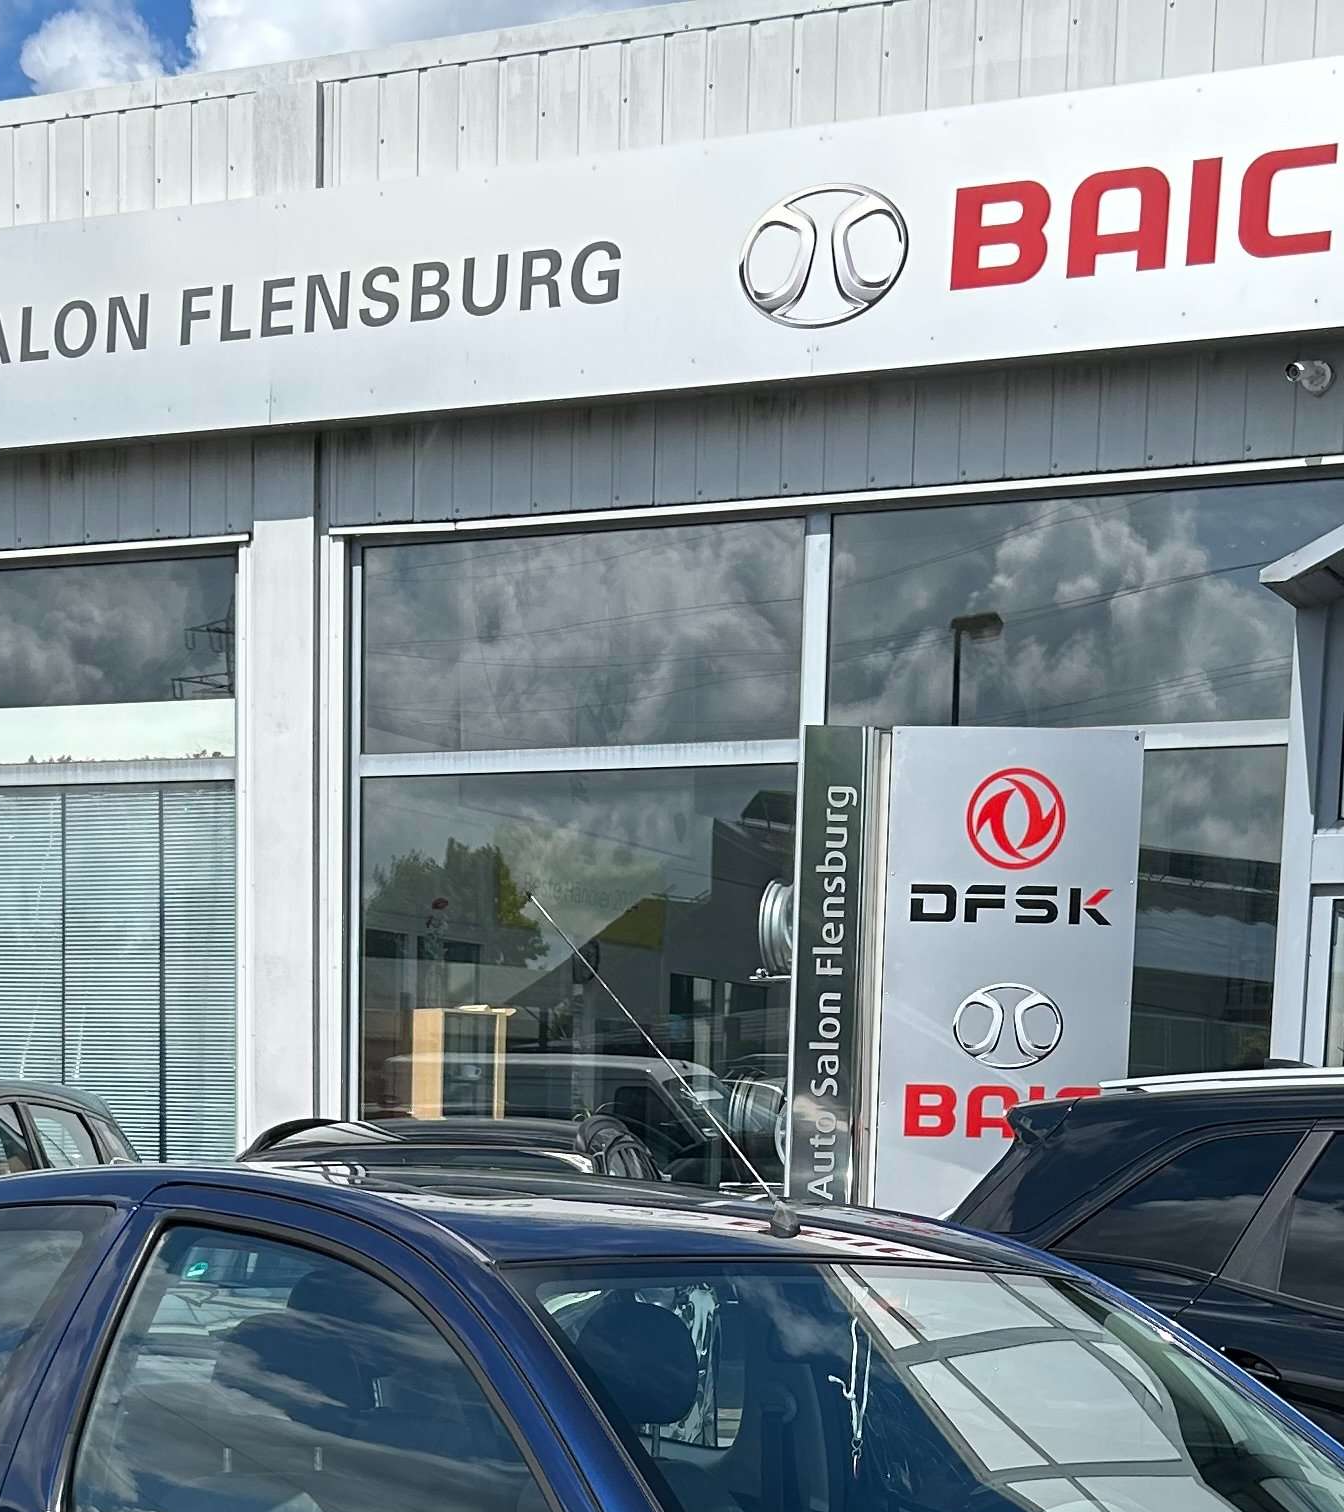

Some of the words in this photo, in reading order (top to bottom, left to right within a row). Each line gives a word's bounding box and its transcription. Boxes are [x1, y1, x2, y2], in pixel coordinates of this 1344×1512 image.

[949, 142, 1339, 292] BAIC
[178, 240, 622, 346] FLENSBURG
[812, 785, 857, 976] Flensburg
[910, 884, 1113, 926] DFSK
[809, 988, 843, 1097] Salon
[807, 1110, 837, 1200] Auto
[903, 1084, 1101, 1139] BA
